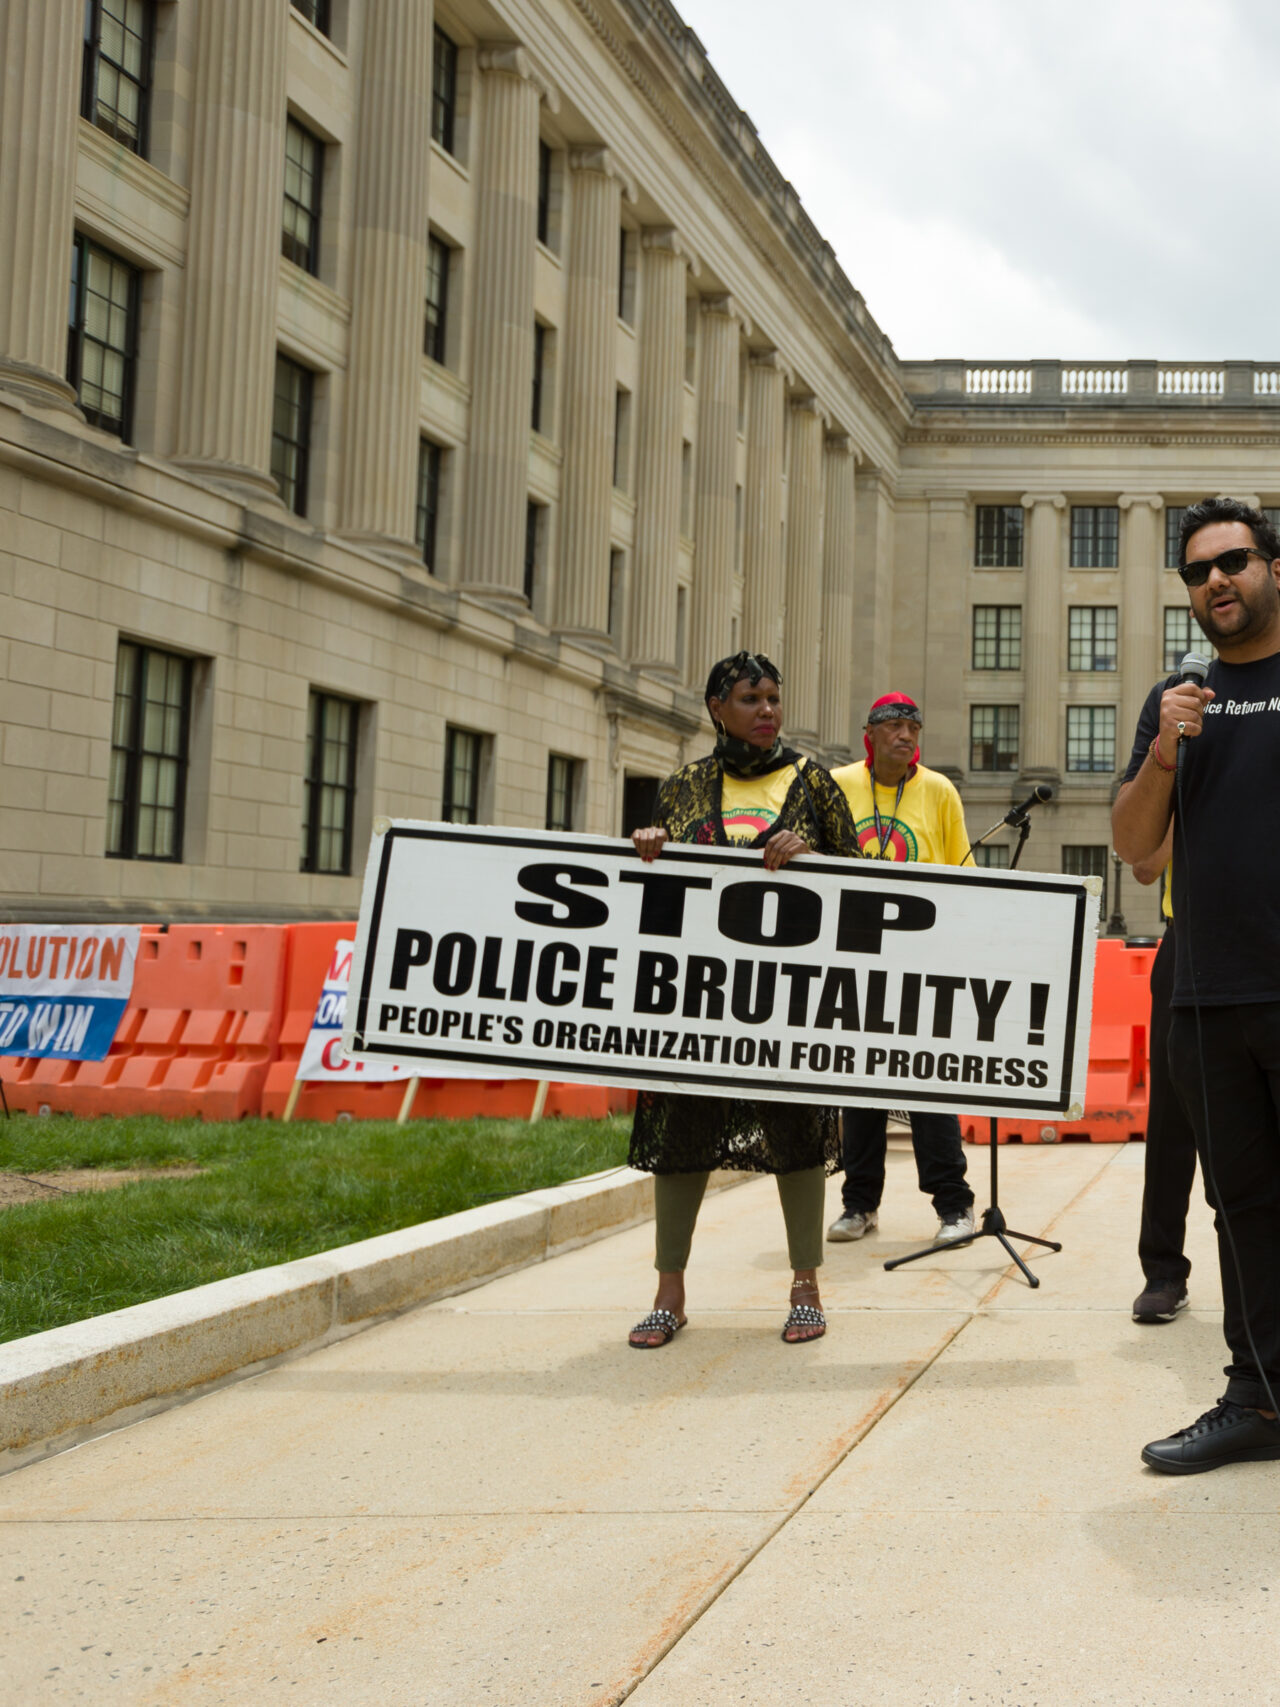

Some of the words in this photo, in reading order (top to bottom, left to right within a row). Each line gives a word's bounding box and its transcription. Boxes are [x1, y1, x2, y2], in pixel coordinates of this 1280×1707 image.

[1225, 700, 1267, 715] Reform
[515, 863, 936, 954] STOP
[390, 928, 617, 1010] POLICE
[29, 1004, 95, 1052] WIN
[379, 1004, 523, 1044] PEOPLE'S
[533, 1019, 780, 1067] ORGANIZATION
[791, 1042, 855, 1073] FOR
[866, 1048, 1048, 1088] PROGRESS
